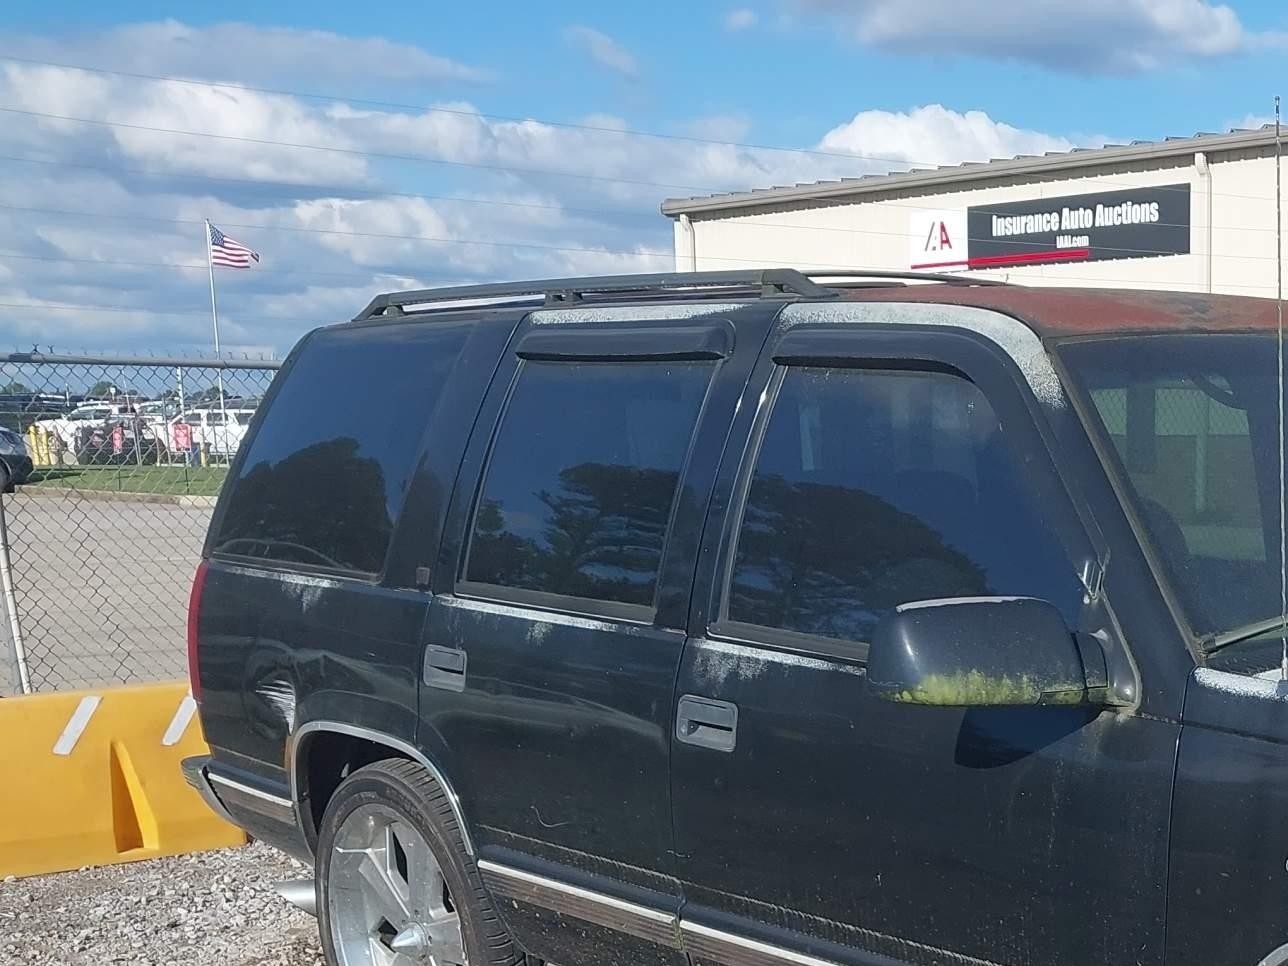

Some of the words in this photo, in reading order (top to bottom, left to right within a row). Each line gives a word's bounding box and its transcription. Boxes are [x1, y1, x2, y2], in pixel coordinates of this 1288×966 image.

[992, 212, 1059, 236] Insurance
[1060, 207, 1094, 230] Auto
[1095, 201, 1159, 227] Auctions
